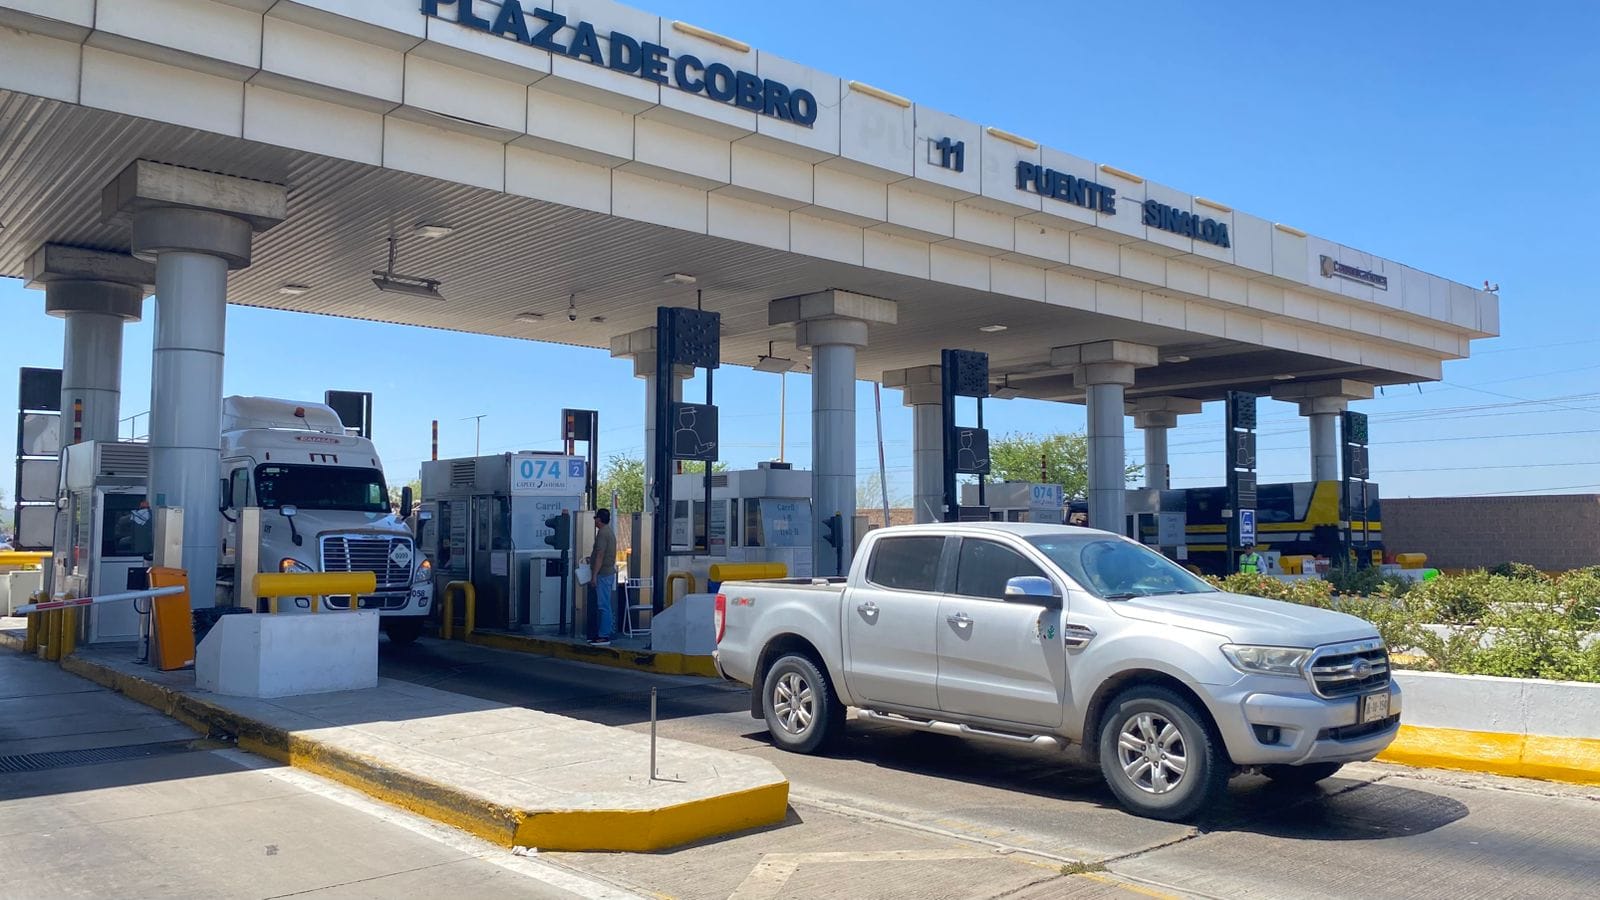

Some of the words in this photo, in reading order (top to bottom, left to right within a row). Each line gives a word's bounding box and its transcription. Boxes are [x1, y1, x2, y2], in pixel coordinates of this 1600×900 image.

[610, 30, 669, 85] DE
[674, 54, 818, 126] COBRO
[936, 136, 965, 173] 11
[1017, 160, 1116, 215] PUENTE
[1145, 199, 1231, 249] SINALOA
[520, 460, 561, 479] 074
[573, 466, 580, 476] 2
[1033, 486, 1053, 499] 074
[535, 501, 561, 510] Carril
